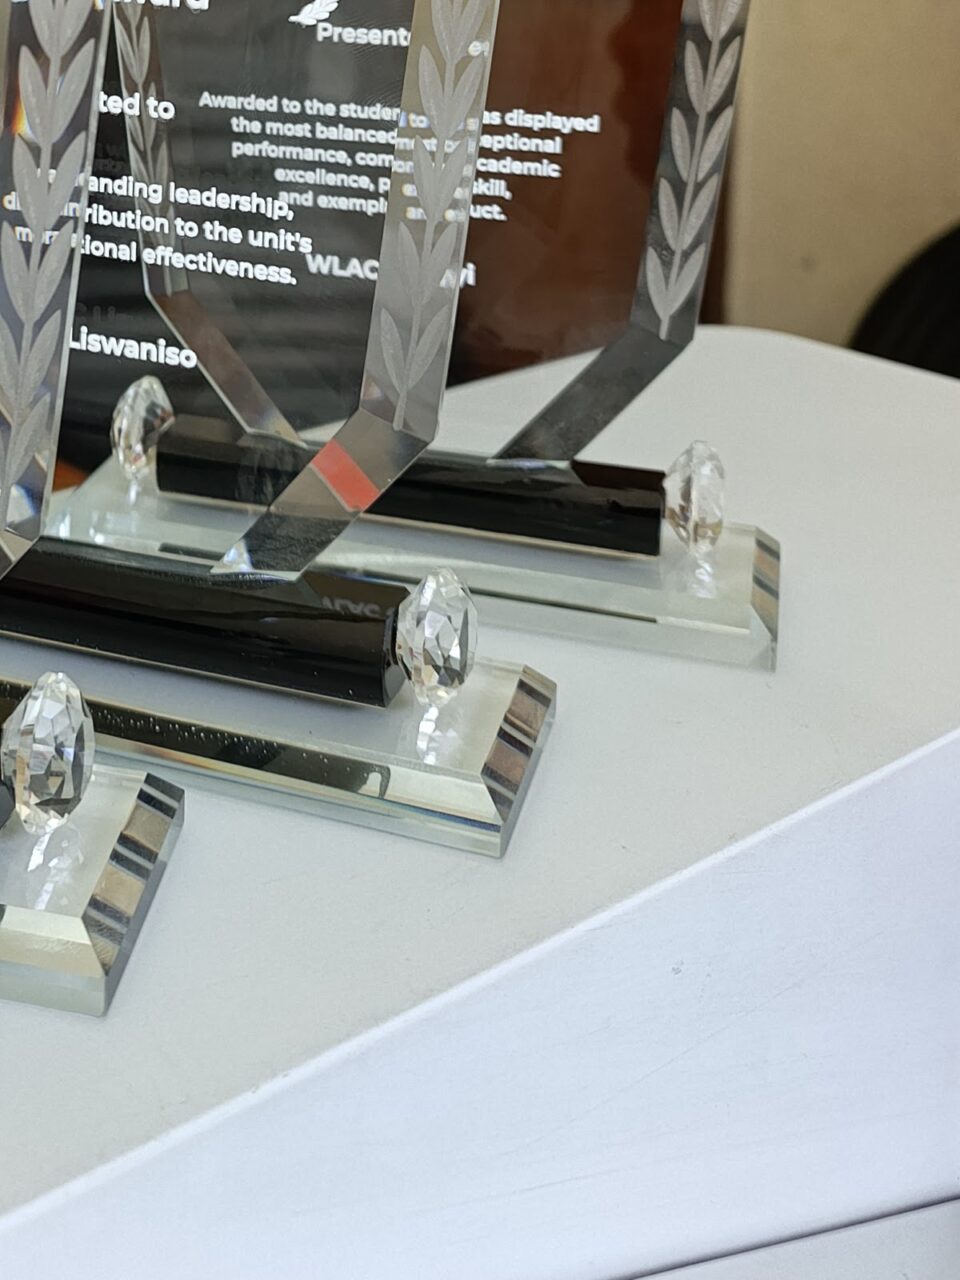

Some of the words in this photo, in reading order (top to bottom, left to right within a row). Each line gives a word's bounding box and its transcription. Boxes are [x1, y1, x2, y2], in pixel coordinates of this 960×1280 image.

[147, 96, 176, 120] to
[199, 91, 278, 114] Awarded
[281, 96, 301, 115] to
[304, 97, 336, 118] the
[504, 108, 601, 134] displayed
[231, 116, 262, 135] the
[265, 120, 312, 139] most
[315, 123, 398, 146] balanced
[231, 140, 353, 168] performance,
[476, 156, 562, 178] cademic
[274, 166, 375, 192] excellence,
[169, 182, 295, 222] leadership,
[278, 188, 314, 208] and
[175, 217, 199, 239] to
[203, 219, 243, 246] the
[247, 226, 313, 254] unit's
[142, 246, 298, 285] effectiveness.
[305, 253, 380, 281] WLAC
